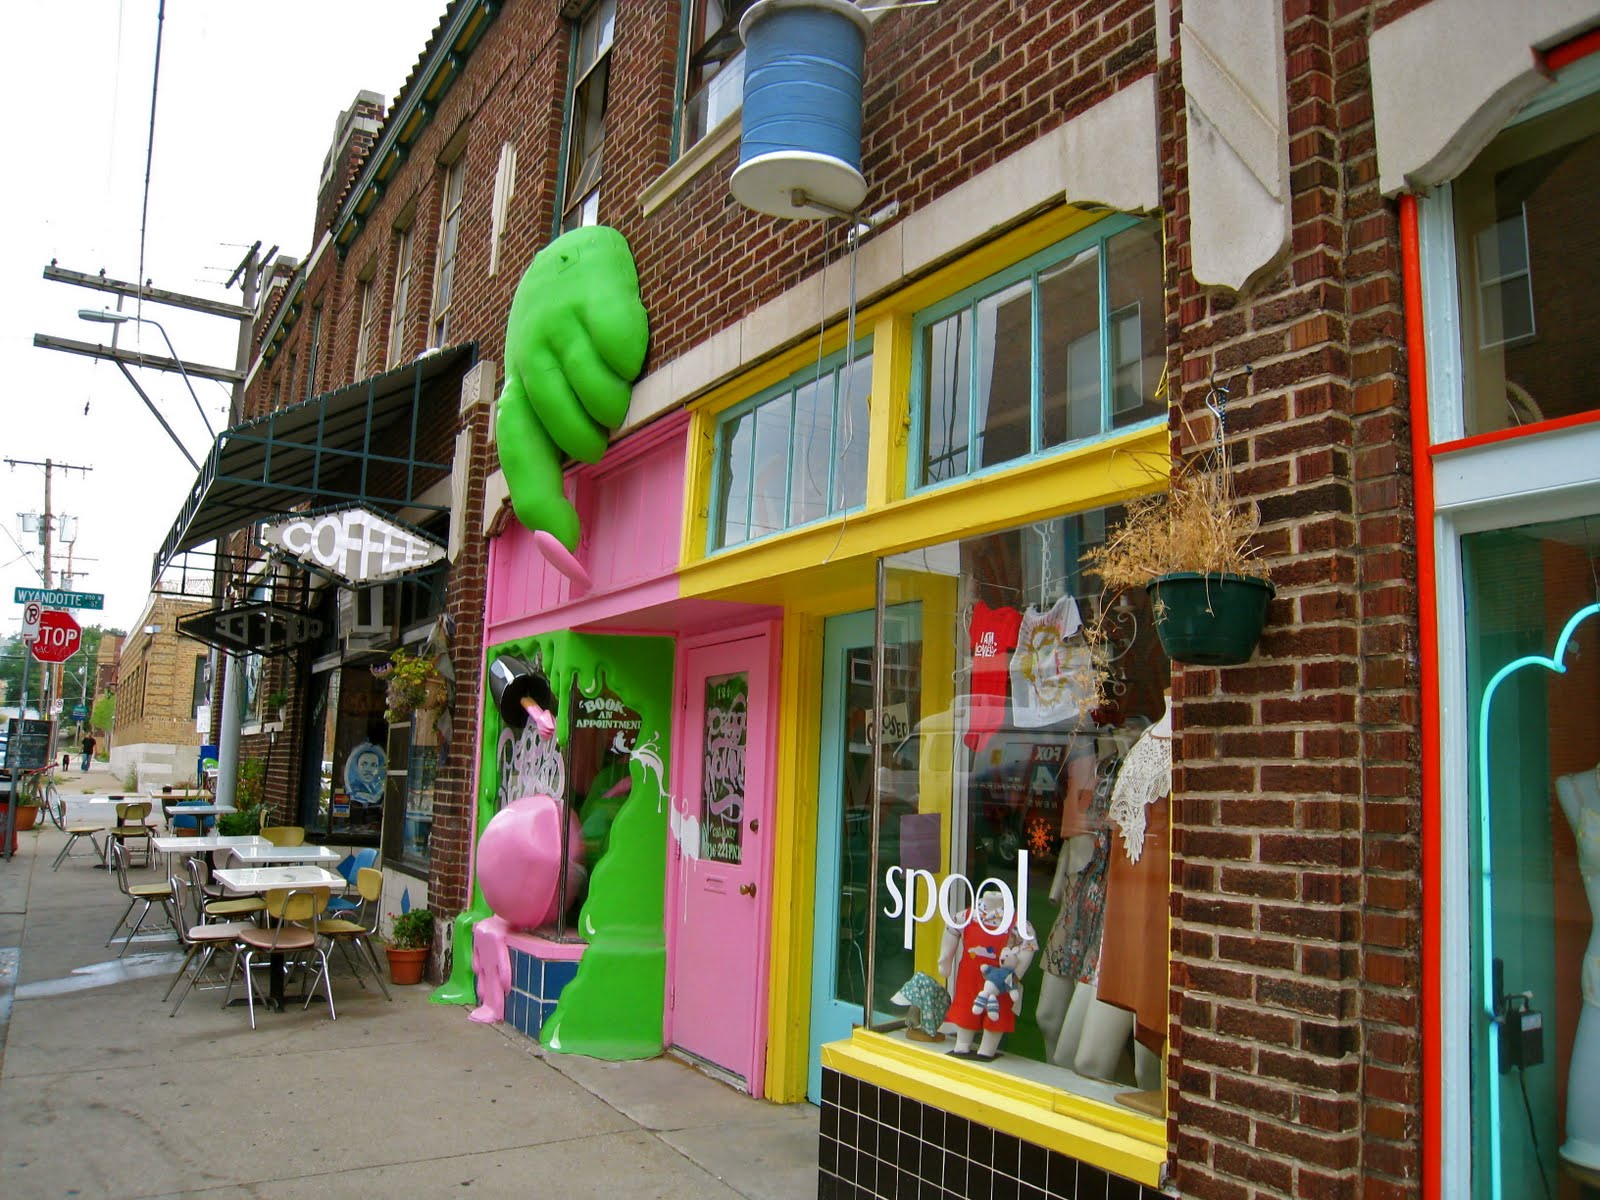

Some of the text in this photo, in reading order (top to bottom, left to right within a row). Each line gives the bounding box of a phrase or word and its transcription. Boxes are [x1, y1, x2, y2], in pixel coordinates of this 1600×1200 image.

[282, 508, 430, 579] COFFEE
[17, 590, 82, 606] WYANDOTTE
[584, 697, 625, 713] BOOK
[598, 711, 613, 719] AN
[576, 719, 642, 729] APPOINTMENT
[867, 712, 909, 745] COSED
[883, 849, 1034, 950] spool
